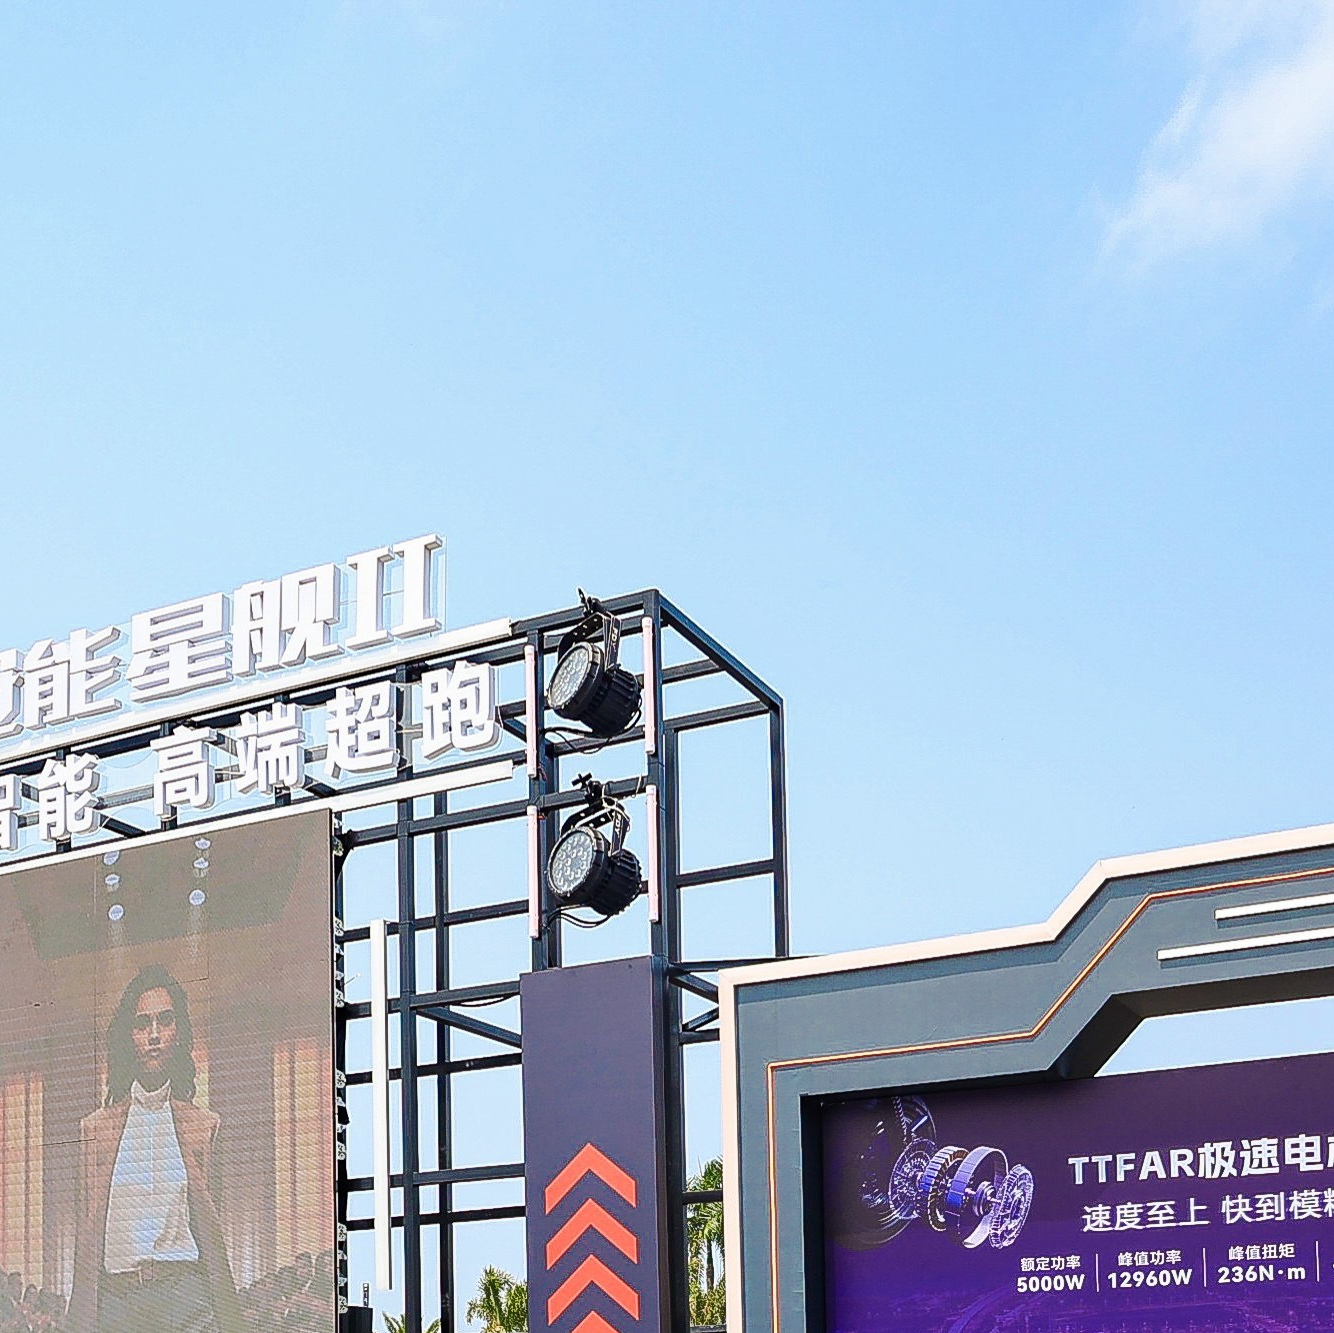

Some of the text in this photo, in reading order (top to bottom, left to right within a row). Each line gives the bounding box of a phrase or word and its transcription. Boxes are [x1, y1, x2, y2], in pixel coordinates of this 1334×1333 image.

[149, 658, 503, 818] 高端超跑
[1081, 1196, 1211, 1233] 速度至上
[1116, 1248, 1182, 1268] 峰值功率
[1227, 1242, 1296, 1262] 峰值扭矩
[1019, 1254, 1082, 1272] 额定功率
[1015, 1272, 1086, 1294] 5000W
[1107, 1268, 1192, 1288] 12960W
